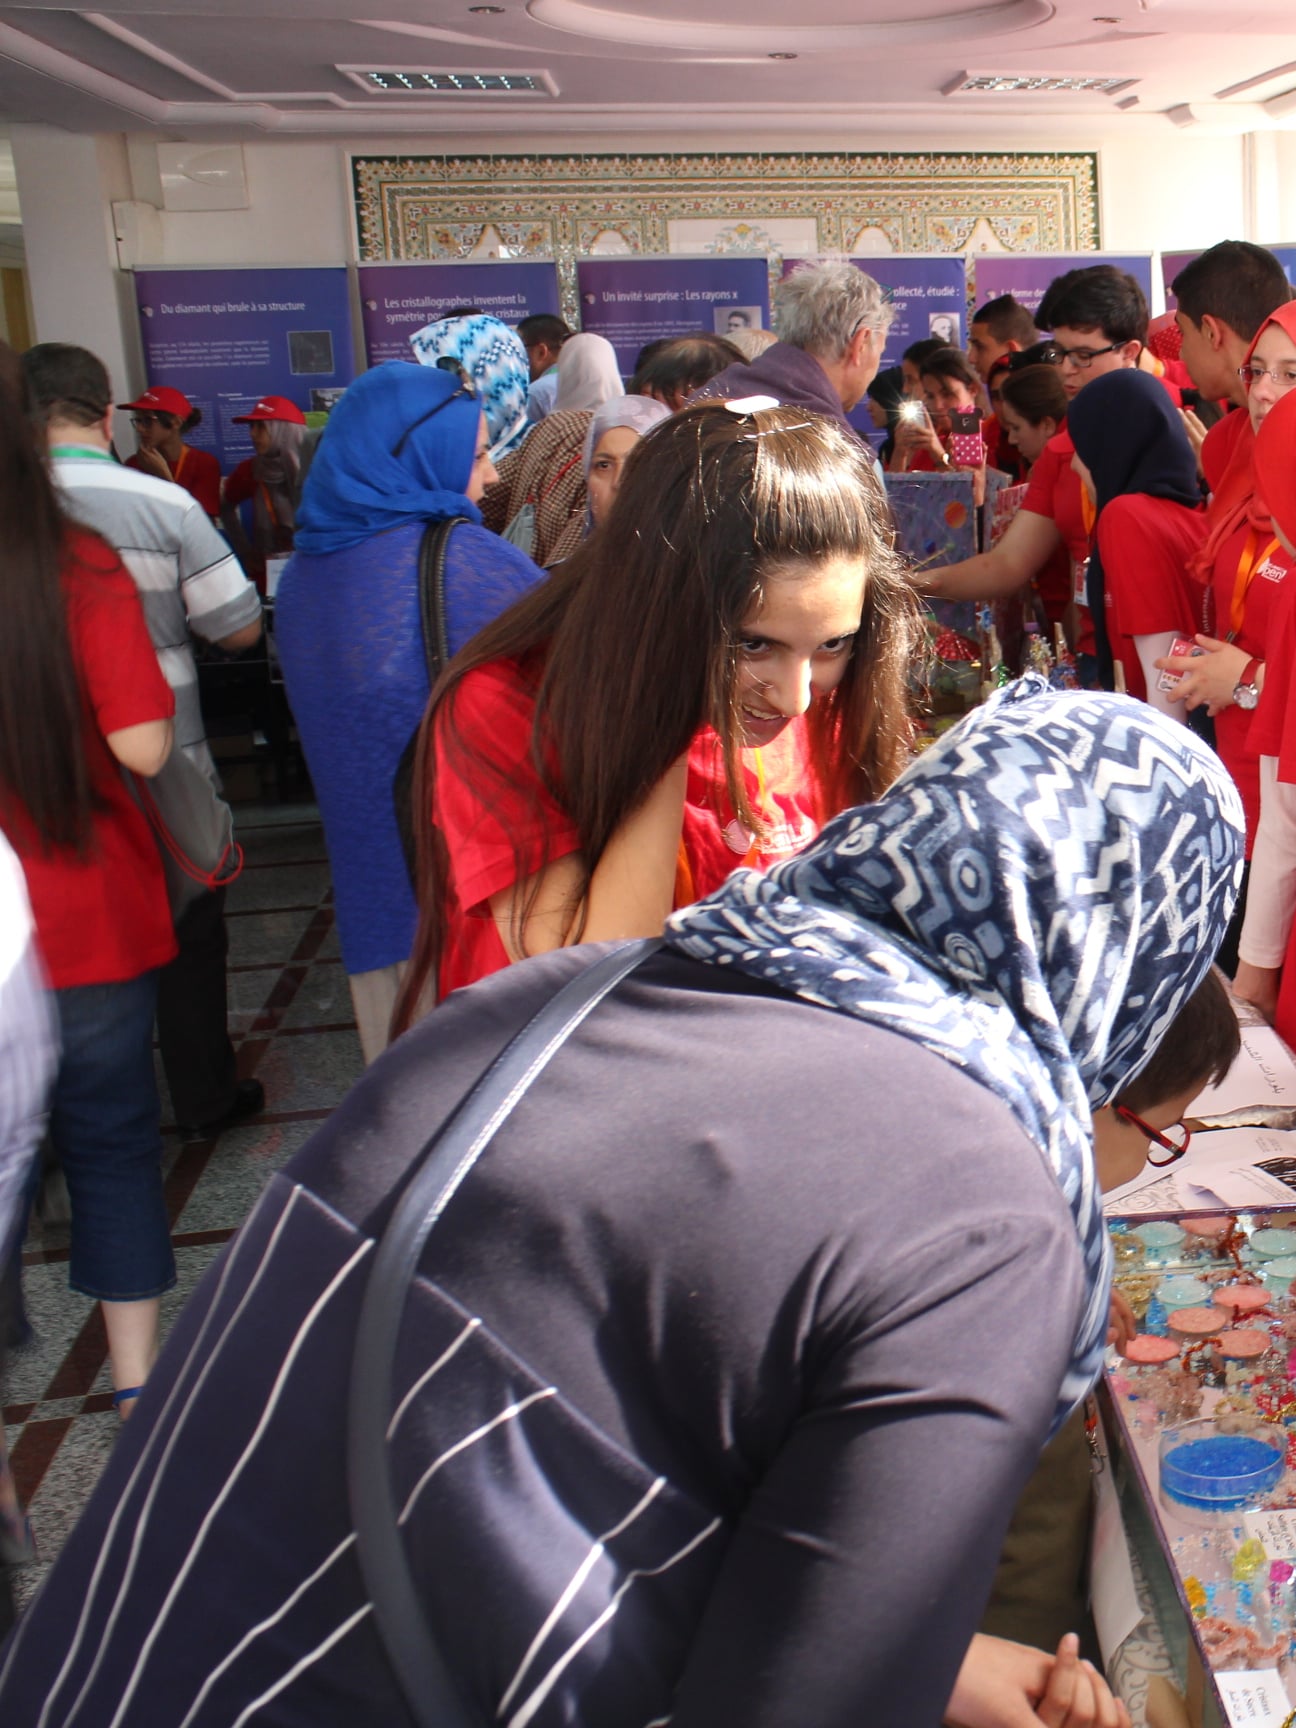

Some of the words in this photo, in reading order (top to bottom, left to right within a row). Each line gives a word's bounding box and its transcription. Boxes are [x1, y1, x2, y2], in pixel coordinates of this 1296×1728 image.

[602, 291, 616, 302] Un
[617, 289, 642, 301] invité
[643, 290, 680, 303] surprise
[685, 290, 701, 301] Les
[701, 291, 731, 303] rayons
[732, 291, 738, 299] x
[892, 286, 926, 298] ollecté,
[927, 285, 955, 297] étudié
[160, 303, 173, 314] Du
[175, 302, 211, 313] diamant
[212, 303, 226, 315] qui
[251, 302, 257, 312] à
[258, 303, 267, 312] sa
[268, 301, 306, 312] structure
[384, 297, 399, 309] Les
[401, 296, 473, 308] cristallographes
[473, 294, 516, 305] inventent
[517, 293, 526, 304] la
[386, 310, 425, 324] symétrie
[495, 307, 530, 318] cristaux
